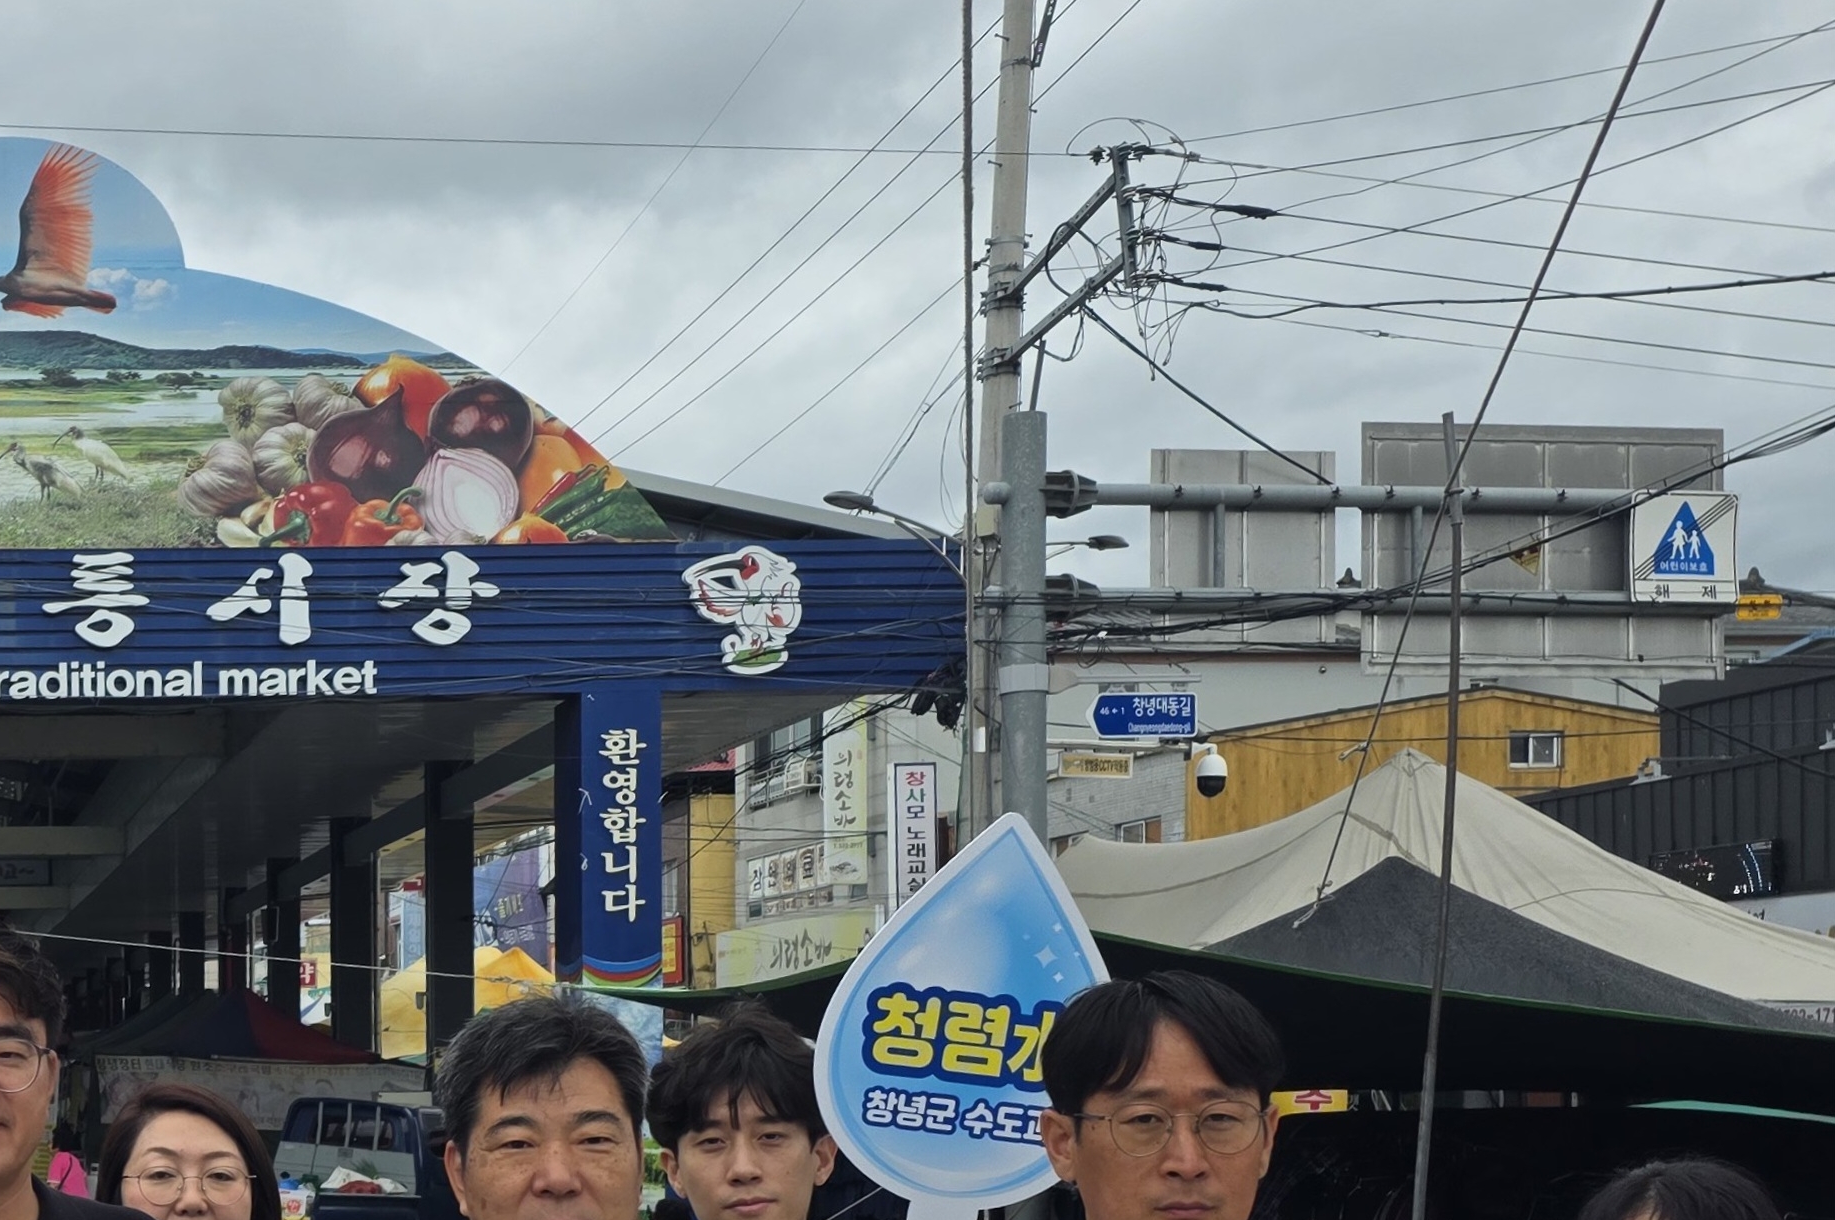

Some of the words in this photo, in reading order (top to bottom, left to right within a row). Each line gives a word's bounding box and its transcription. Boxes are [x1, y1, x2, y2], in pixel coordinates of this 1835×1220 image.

[1659, 561, 1708, 572] 어린이보호
[218, 660, 378, 696] market
[1132, 697, 1192, 717] 창녕대동길
[599, 728, 647, 923] 환영합니다
[866, 1090, 956, 1131] 창녕군
